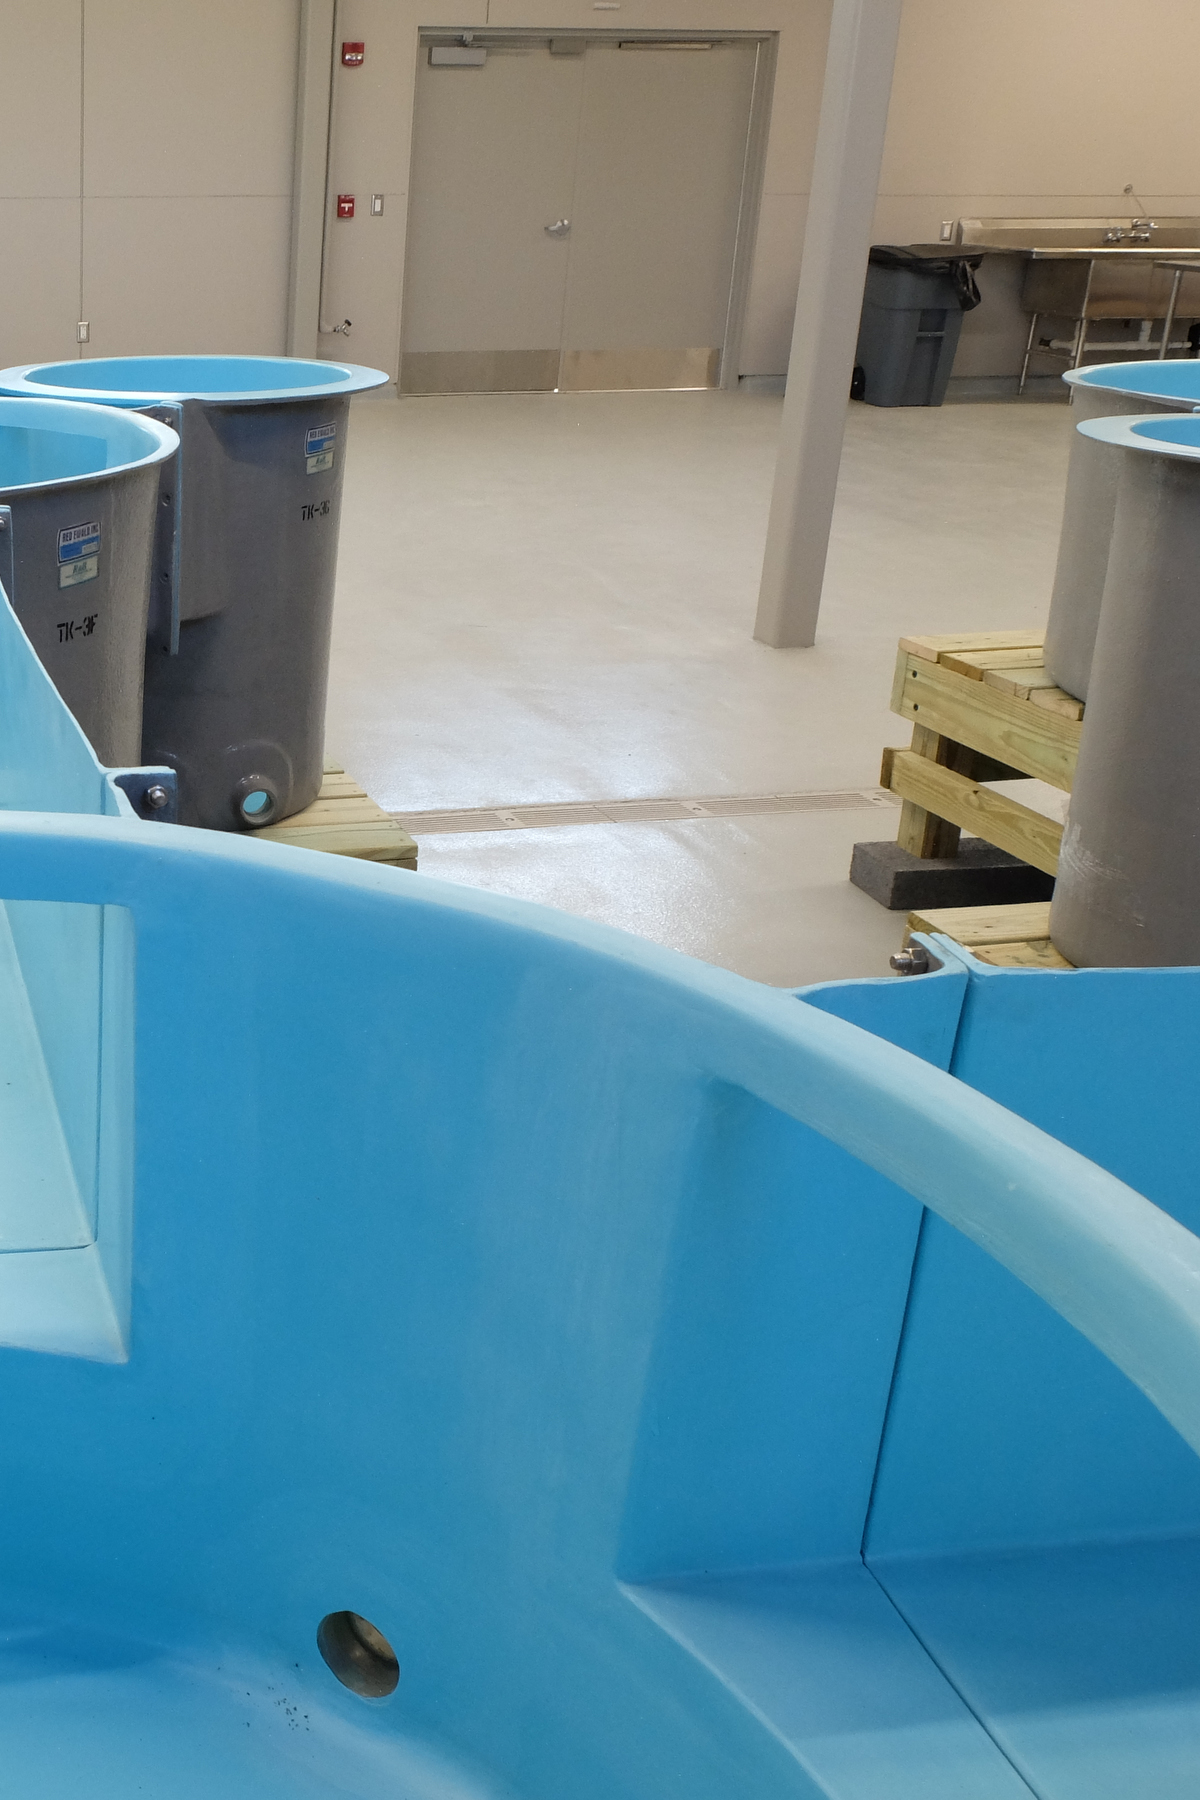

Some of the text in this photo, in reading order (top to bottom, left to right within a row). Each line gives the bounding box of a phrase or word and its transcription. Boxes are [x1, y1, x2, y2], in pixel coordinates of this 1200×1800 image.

[62, 523, 99, 543] RED EWALD INC
[57, 613, 98, 643] TK-3F
